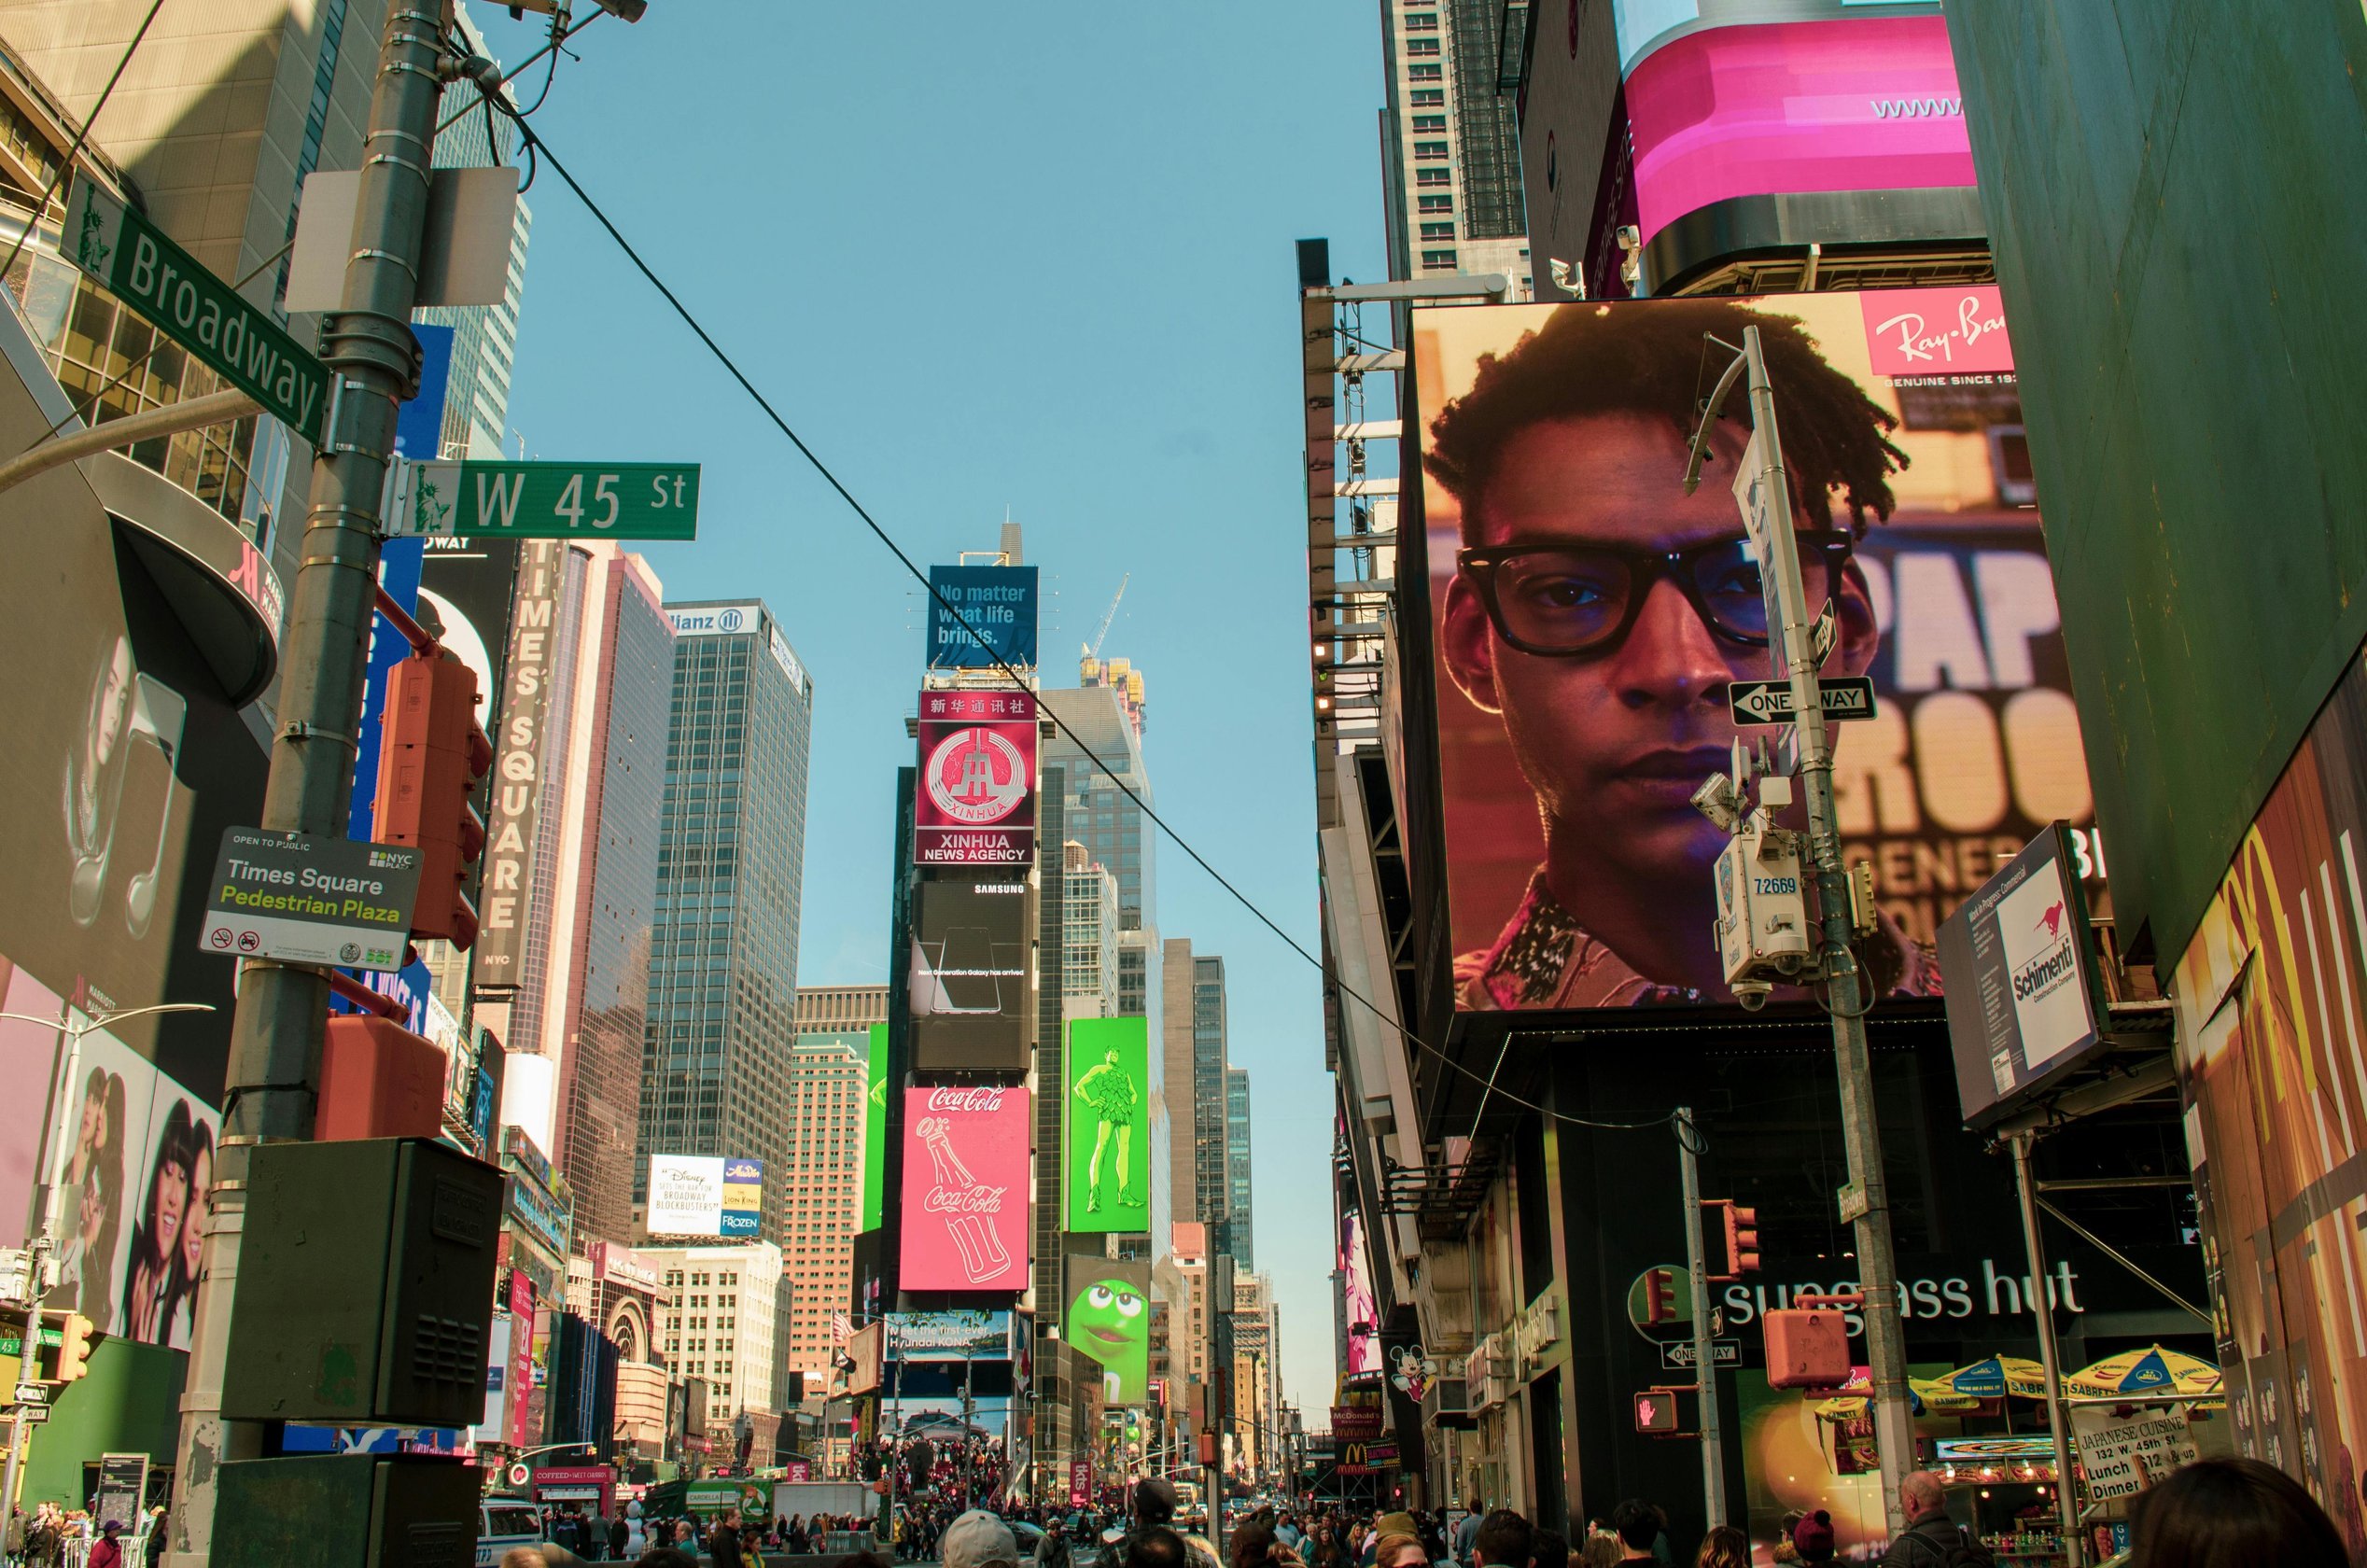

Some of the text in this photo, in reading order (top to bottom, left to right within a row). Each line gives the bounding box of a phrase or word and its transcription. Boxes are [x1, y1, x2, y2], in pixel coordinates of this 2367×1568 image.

[129, 232, 320, 433] Broadway
[1884, 376, 1946, 388] GENUINE
[1952, 375, 1993, 385] SINCE
[476, 472, 687, 529] W 45 St
[940, 584, 1026, 602] No matter
[670, 614, 714, 630] lianz
[939, 605, 1014, 623] what life
[938, 626, 998, 648] brings.
[931, 698, 1025, 714] 新华通讯社
[1751, 693, 1792, 711] ONE
[489, 539, 557, 928] TIMES SQUARE
[948, 801, 1008, 819] XINHUA
[233, 834, 311, 851] OPEN TO PUBLIC
[941, 833, 1010, 848] XINHUA
[385, 852, 413, 865] NYC
[925, 848, 1025, 861] NEWS AGENCY
[228, 859, 384, 895] Times Square
[974, 885, 1024, 894] SAMSUNG
[220, 885, 399, 923] Pedestrian Plaza
[484, 954, 510, 965] NYC
[968, 969, 988, 977] Galaxy
[2013, 937, 2073, 1001] Schimenti
[2033, 972, 2075, 1003] Construction Company
[928, 1086, 1006, 1112] Coca-Cola
[664, 1191, 707, 1201] BROADWAY
[924, 1185, 1007, 1213] Coca-Cola
[1840, 1191, 1866, 1217] Broadway
[722, 1215, 757, 1229] FROZEN
[1725, 1259, 2085, 1337] sungass hut
[920, 1325, 936, 1335] the
[940, 1324, 988, 1335] first-ever
[938, 1337, 973, 1347] KONA.
[1674, 1350, 1696, 1360] ONE
[2174, 1367, 2208, 1380] SABRETT
[2011, 1381, 2068, 1395] SABRT
[2081, 1416, 2185, 1449] JAPANESE CUISINE
[2095, 1435, 2179, 1461] 132 W. 45th St.
[2087, 1462, 2130, 1481] Lunch
[2183, 1449, 2195, 1461] up
[1075, 1463, 1088, 1491] tkts
[2093, 1479, 2139, 1500] Dinner
[476, 1548, 493, 1562] YPD
